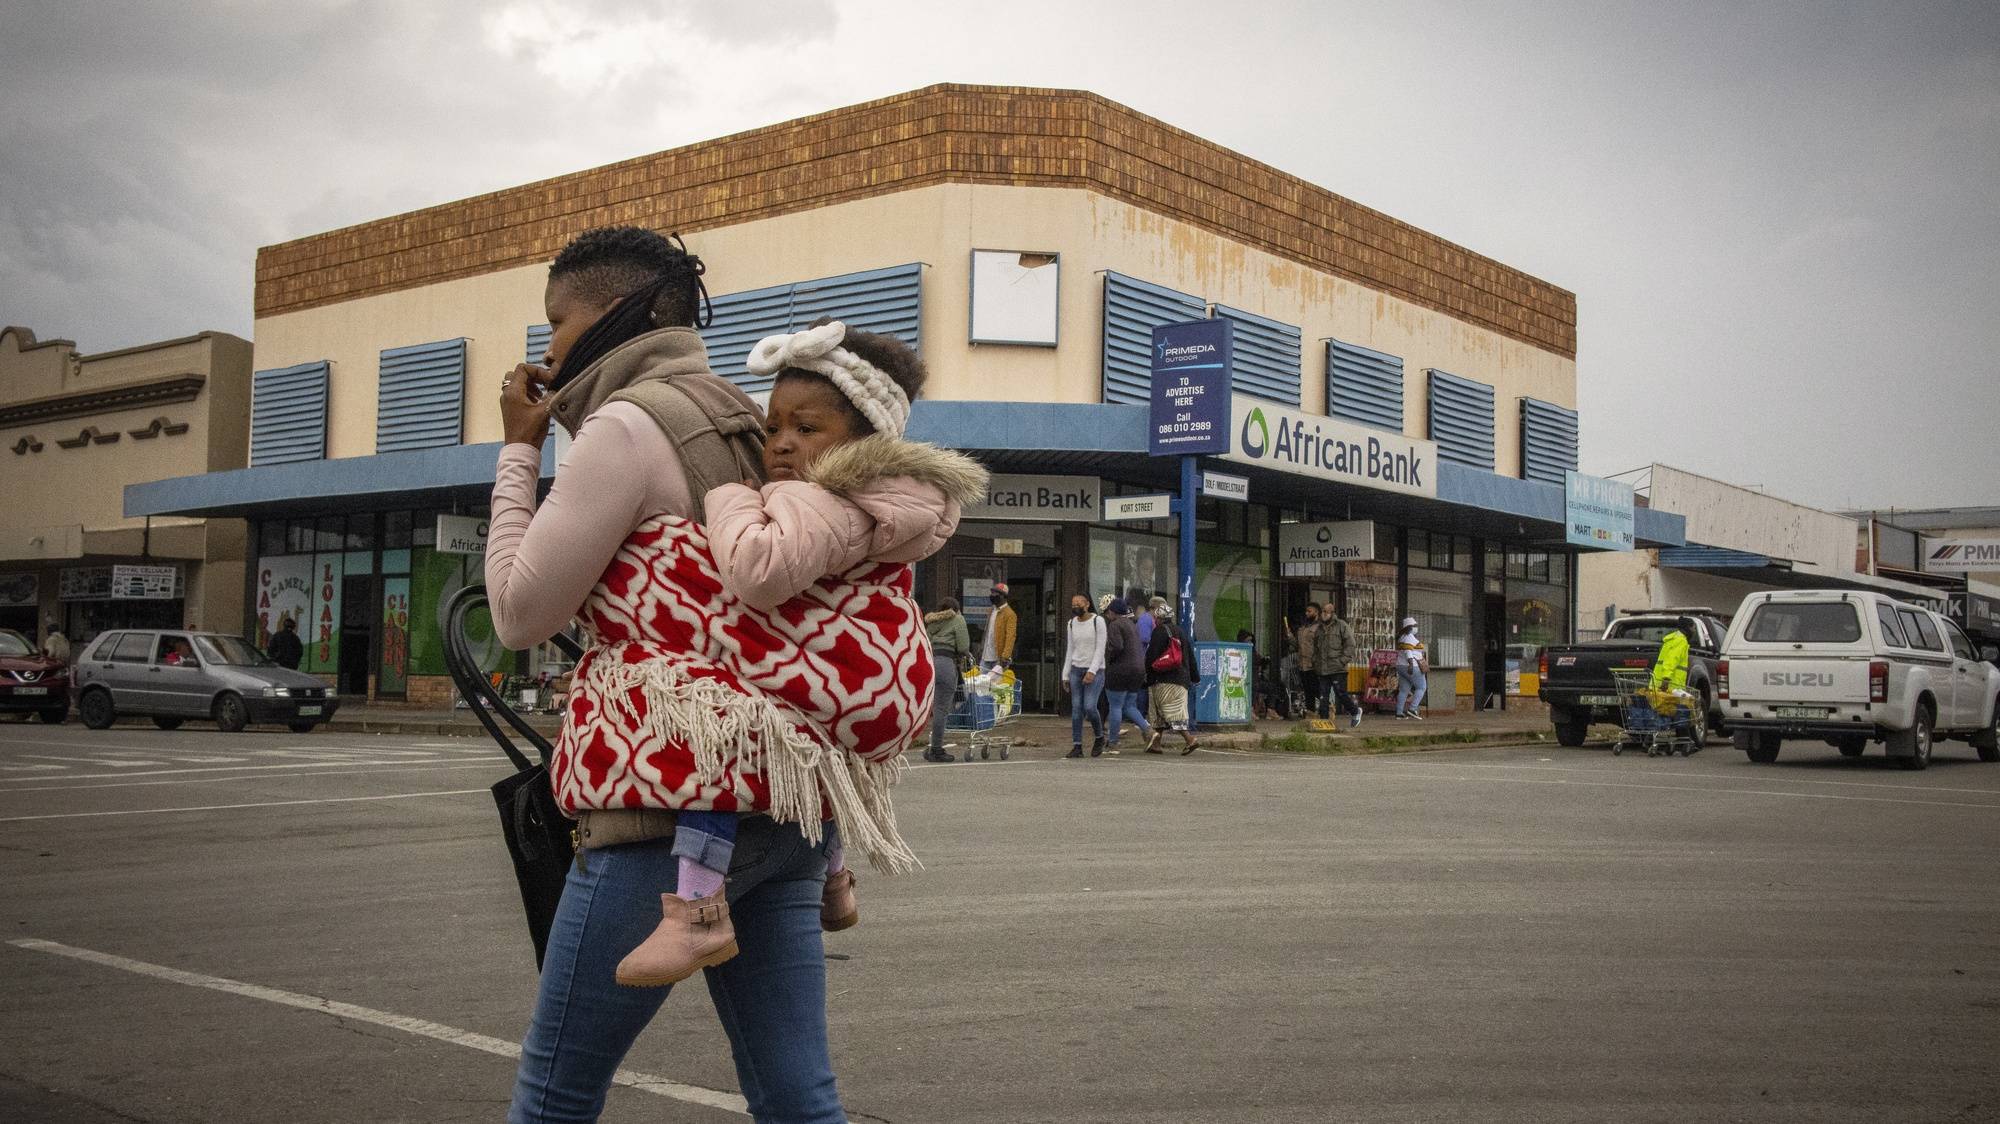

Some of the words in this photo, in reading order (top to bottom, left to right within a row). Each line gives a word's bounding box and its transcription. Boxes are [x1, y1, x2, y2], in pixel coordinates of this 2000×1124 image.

[1165, 344, 1216, 356] PRIMEDIA
[1165, 355, 1198, 363] OUTDOOR
[1179, 377, 1189, 386] TO
[1165, 385, 1205, 397] ADVERTISE
[1175, 397, 1194, 407] HERE
[1176, 413, 1191, 422] Call
[1159, 425, 1173, 434] 086
[1174, 423, 1189, 433] 010
[1190, 422, 1211, 431] 2989
[1273, 416, 1362, 475] African
[1367, 436, 1421, 487] Bank
[987, 486, 1032, 507] ican
[1037, 487, 1092, 509] Bank
[1121, 503, 1134, 513] KORT
[1135, 502, 1153, 513] STREET
[450, 538, 487, 552] African
[1289, 546, 1330, 560] African
[1332, 545, 1361, 558] Bank
[319, 563, 334, 663] LOANS
[1763, 672, 1834, 687] ISUZU
